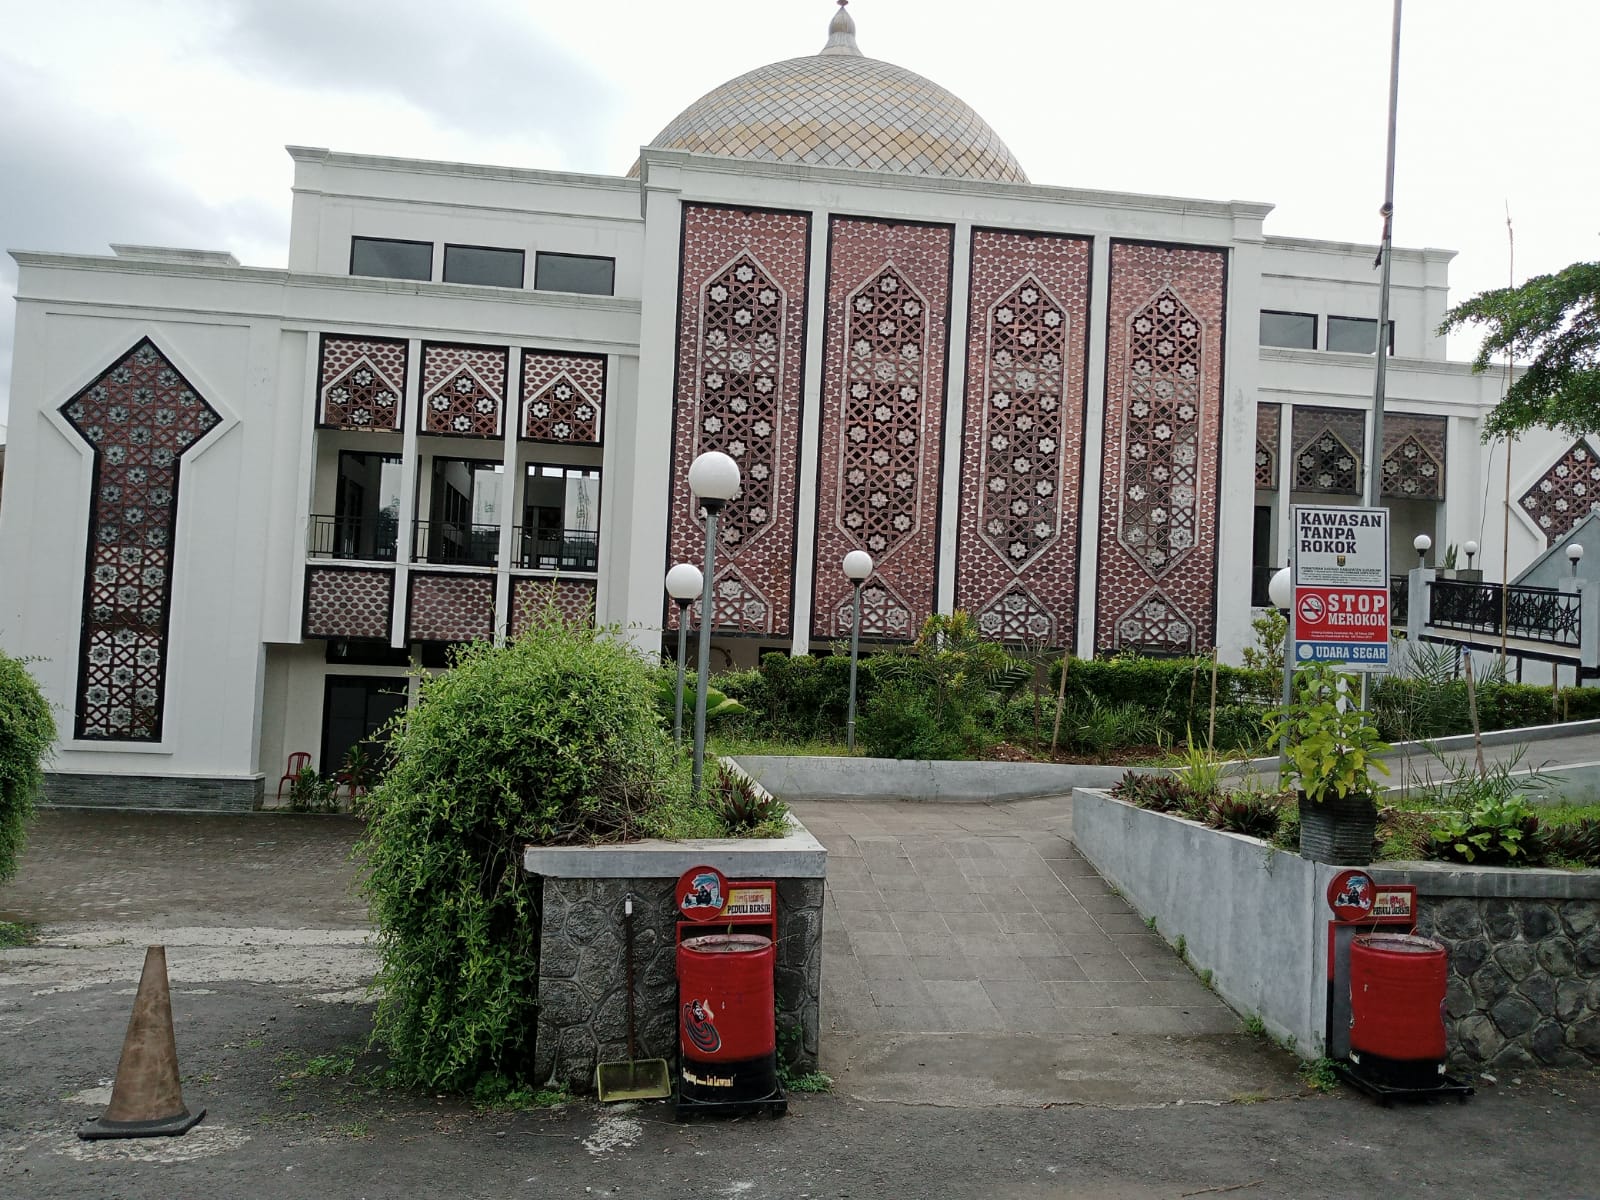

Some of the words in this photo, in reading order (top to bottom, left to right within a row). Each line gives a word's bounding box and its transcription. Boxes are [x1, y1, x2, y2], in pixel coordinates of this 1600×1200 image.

[1300, 512, 1382, 528] KAWASAN
[1300, 526, 1356, 540] TANPA
[1300, 540, 1357, 554] ROKOK
[1328, 594, 1385, 613] STOP
[1327, 612, 1386, 626] MEROKOK
[1315, 646, 1350, 659] UDARA
[1352, 647, 1386, 660] SEGAR
[727, 904, 748, 915] PEDULI
[749, 903, 771, 914] BERSIH
